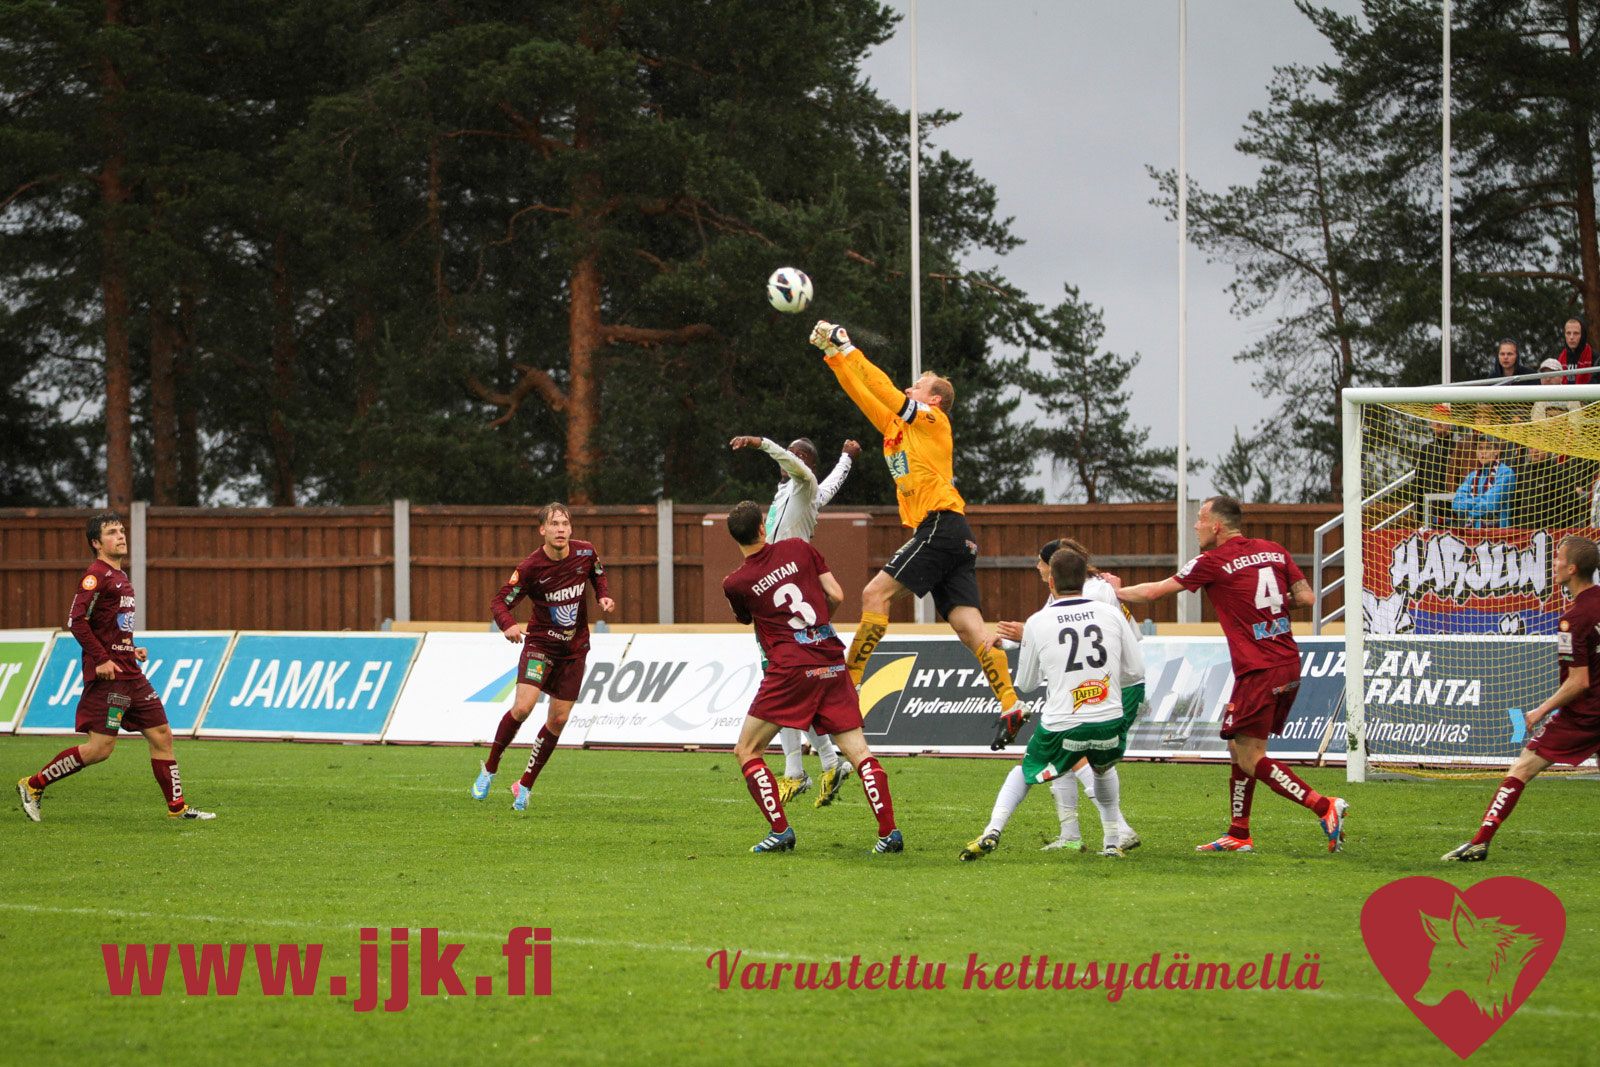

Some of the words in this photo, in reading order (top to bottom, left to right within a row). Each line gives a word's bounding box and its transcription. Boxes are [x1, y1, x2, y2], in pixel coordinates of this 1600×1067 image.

[751, 561, 799, 597] REINTAM
[1222, 552, 1286, 575] V.GELDEREN
[1390, 530, 1551, 605] HARJUN
[545, 582, 585, 602] HARVIA
[773, 582, 817, 630] 3
[1254, 566, 1284, 615] 4
[1057, 611, 1095, 624] BRIGHT
[1058, 624, 1107, 673] 23
[230, 660, 392, 710] JAMK.FI
[1073, 687, 1101, 702] TAFFEL
[1364, 678, 1481, 706] RANTA
[711, 714, 743, 730] years
[42, 754, 81, 781] TOTAL
[525, 736, 545, 774] TOTAL
[753, 767, 782, 822] TOTAL
[860, 761, 885, 815] TOTAL
[1232, 777, 1250, 818] TOTAL
[1269, 763, 1307, 801] TOTAL
